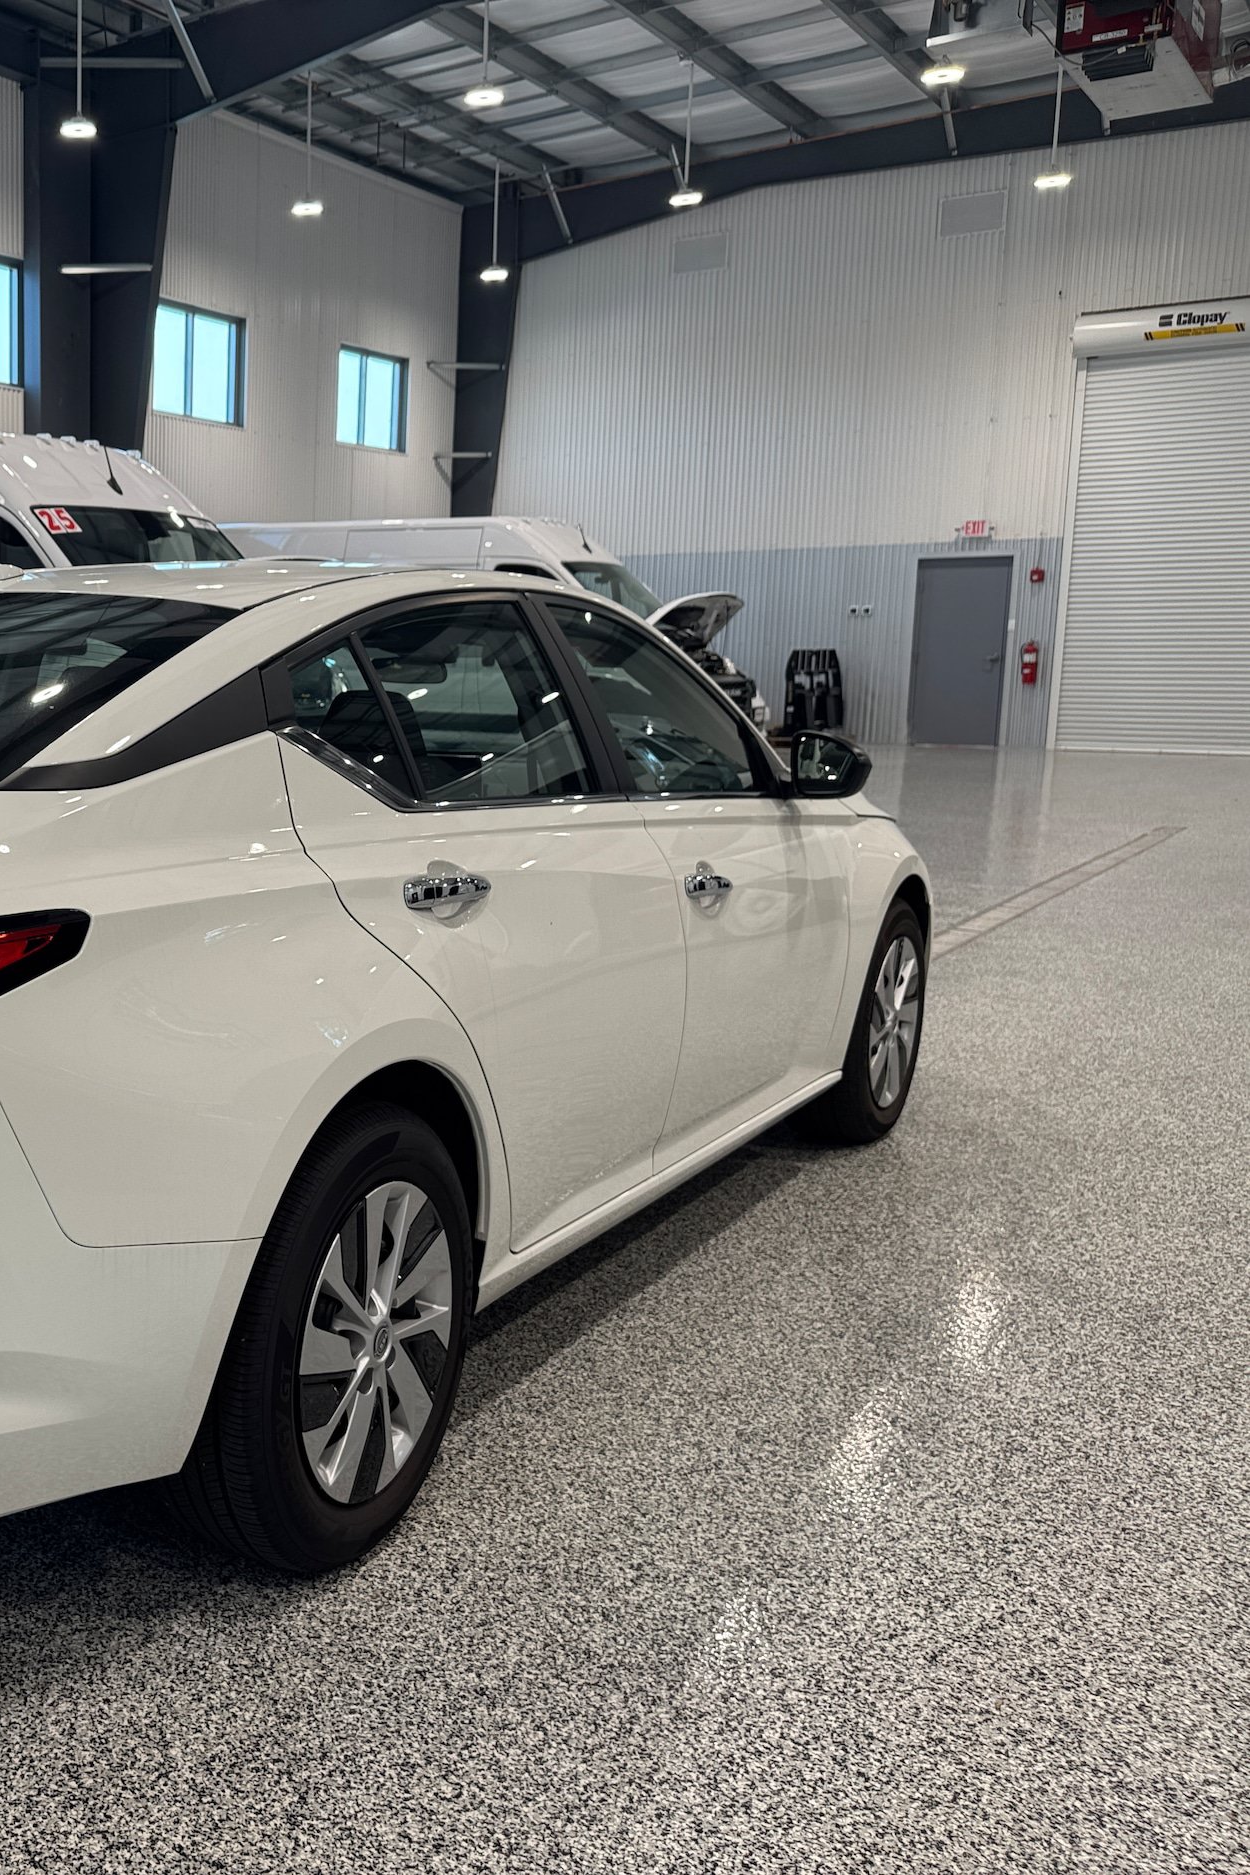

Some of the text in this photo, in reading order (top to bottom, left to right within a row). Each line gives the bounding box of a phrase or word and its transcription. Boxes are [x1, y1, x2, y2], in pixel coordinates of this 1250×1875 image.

[1176, 312, 1228, 326] Clopay
[38, 508, 75, 530] 25
[965, 520, 985, 535] EXIT
